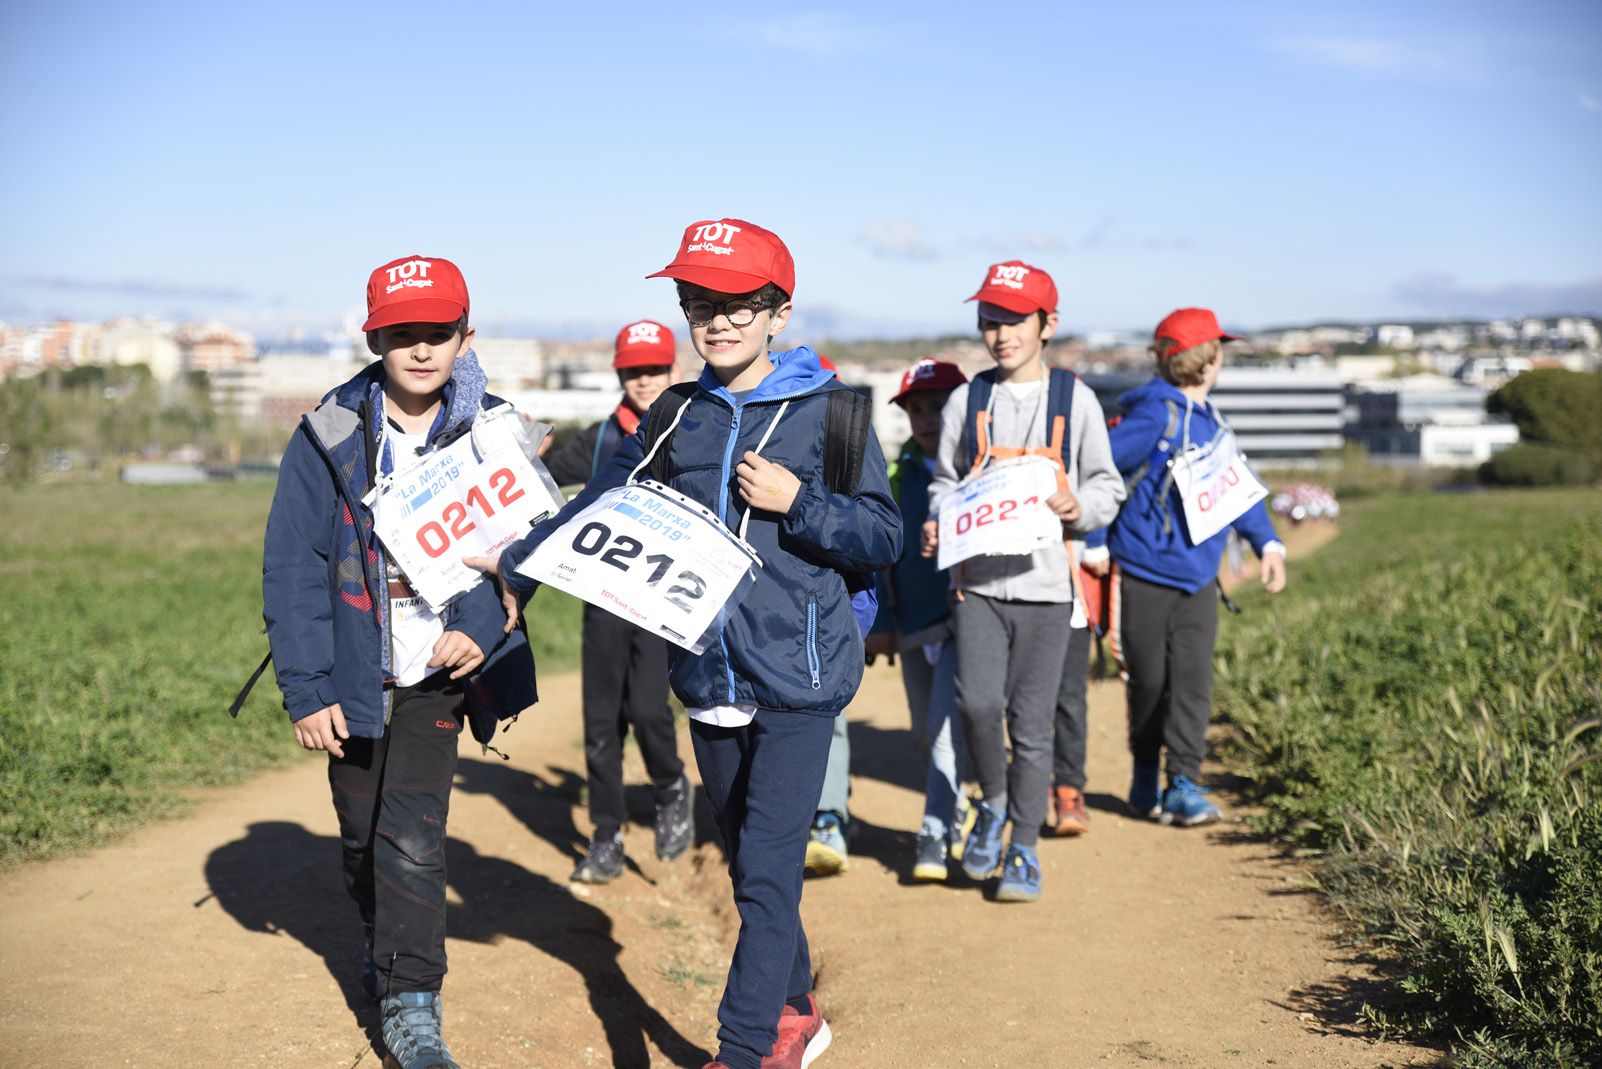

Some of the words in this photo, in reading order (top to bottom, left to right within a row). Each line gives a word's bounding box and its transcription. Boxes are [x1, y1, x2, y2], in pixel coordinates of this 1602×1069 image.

[692, 222, 741, 245] TOT
[385, 260, 431, 283] TOT
[995, 265, 1029, 282] TOT
[418, 454, 454, 487] Marxa
[415, 467, 526, 558] 0212
[642, 497, 692, 530] Marxa
[557, 562, 577, 574] Amat
[571, 521, 708, 614] 0212
